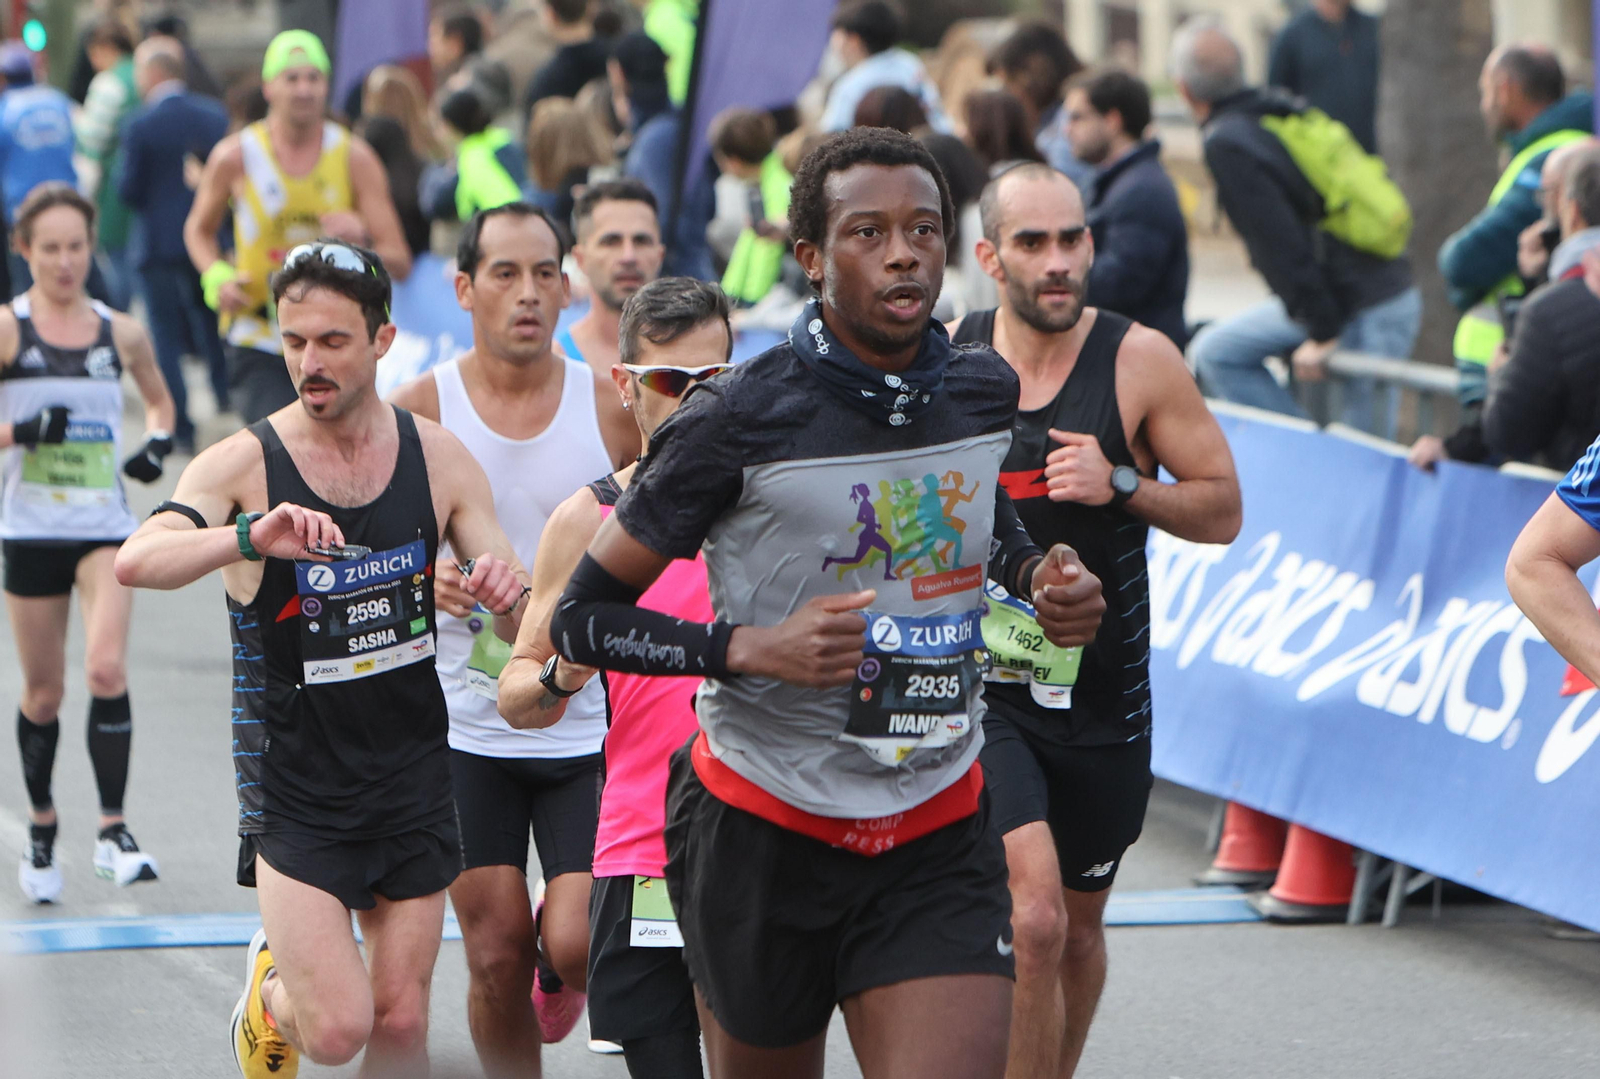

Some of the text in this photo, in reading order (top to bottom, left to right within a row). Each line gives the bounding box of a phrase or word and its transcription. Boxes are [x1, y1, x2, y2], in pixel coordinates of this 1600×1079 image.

[344, 552, 413, 584] ZURICH
[917, 579, 952, 594] Agualva
[346, 597, 391, 625] 2596
[348, 628, 398, 653] SASHA
[909, 619, 973, 647] ZURICH
[1007, 624, 1044, 653] 1462
[904, 674, 960, 699] 2935
